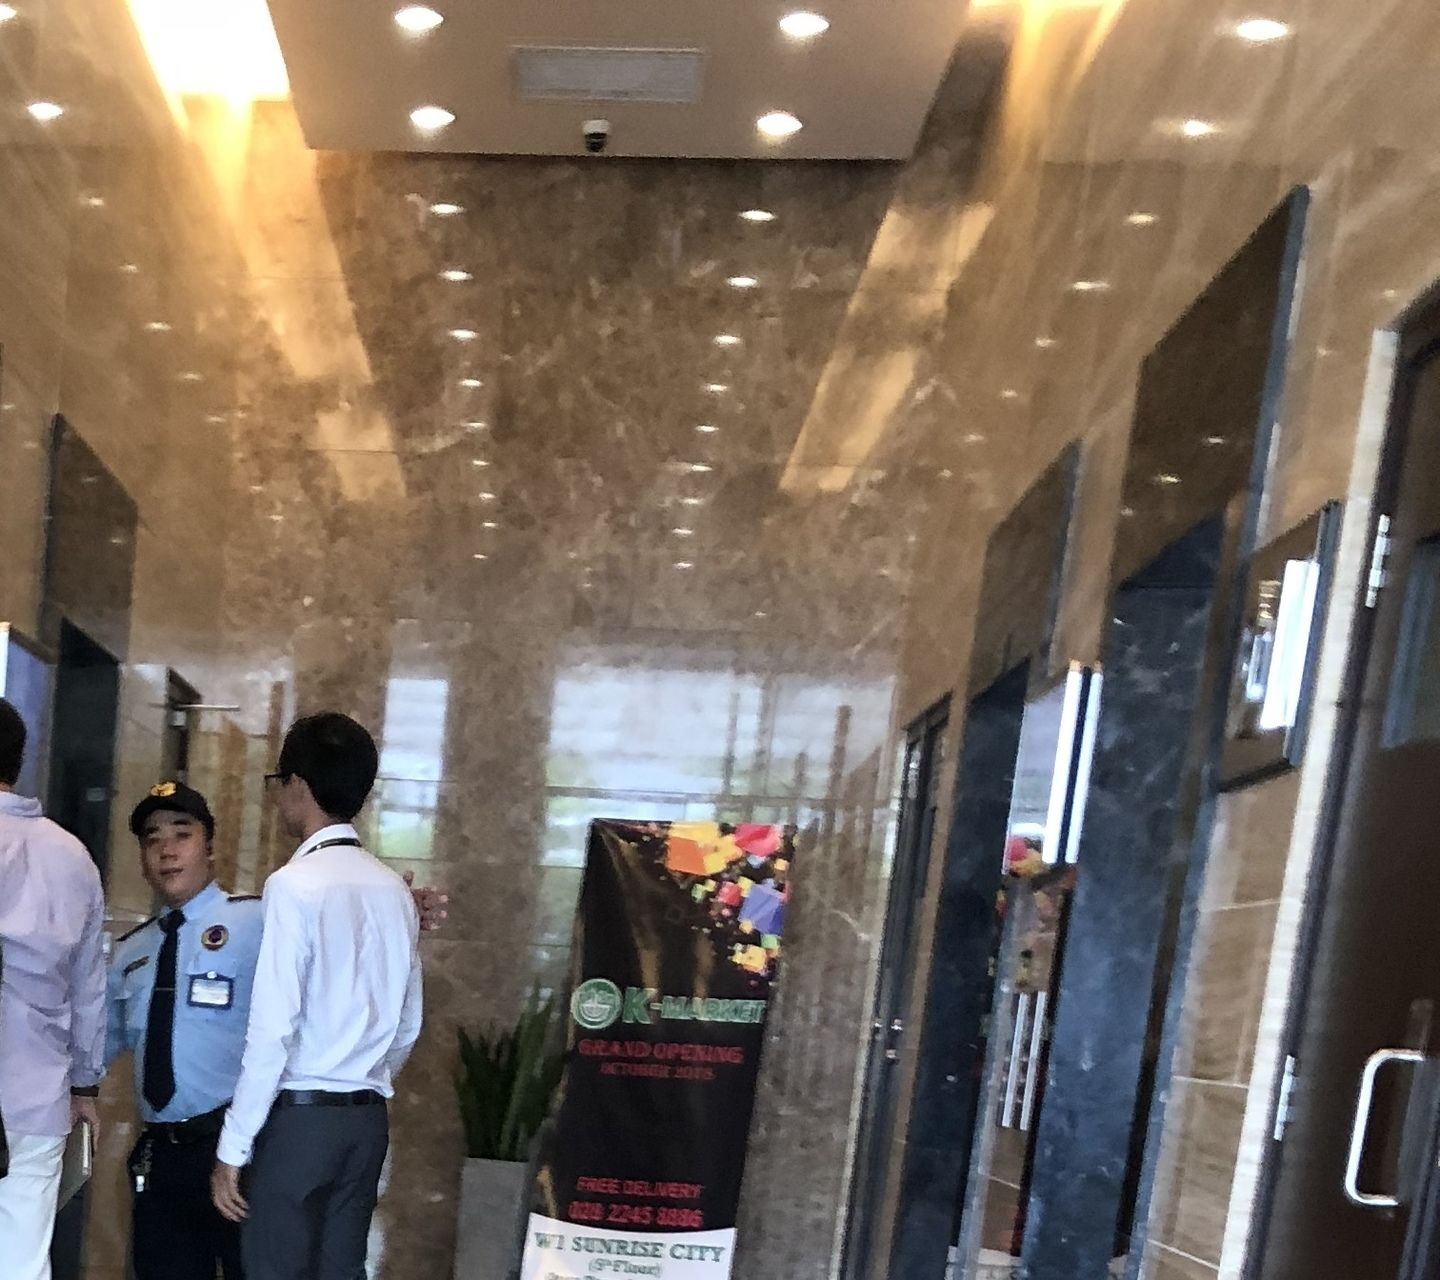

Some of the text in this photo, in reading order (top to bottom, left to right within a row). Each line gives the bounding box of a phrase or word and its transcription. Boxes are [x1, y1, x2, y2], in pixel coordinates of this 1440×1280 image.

[578, 1039, 744, 1063] GRAND OPENING
[576, 1176, 703, 1199] FREE DELIVERY
[606, 1203, 652, 1224] 2245
[571, 1236, 665, 1258] SUNRISE
[669, 1243, 725, 1262] CITY
